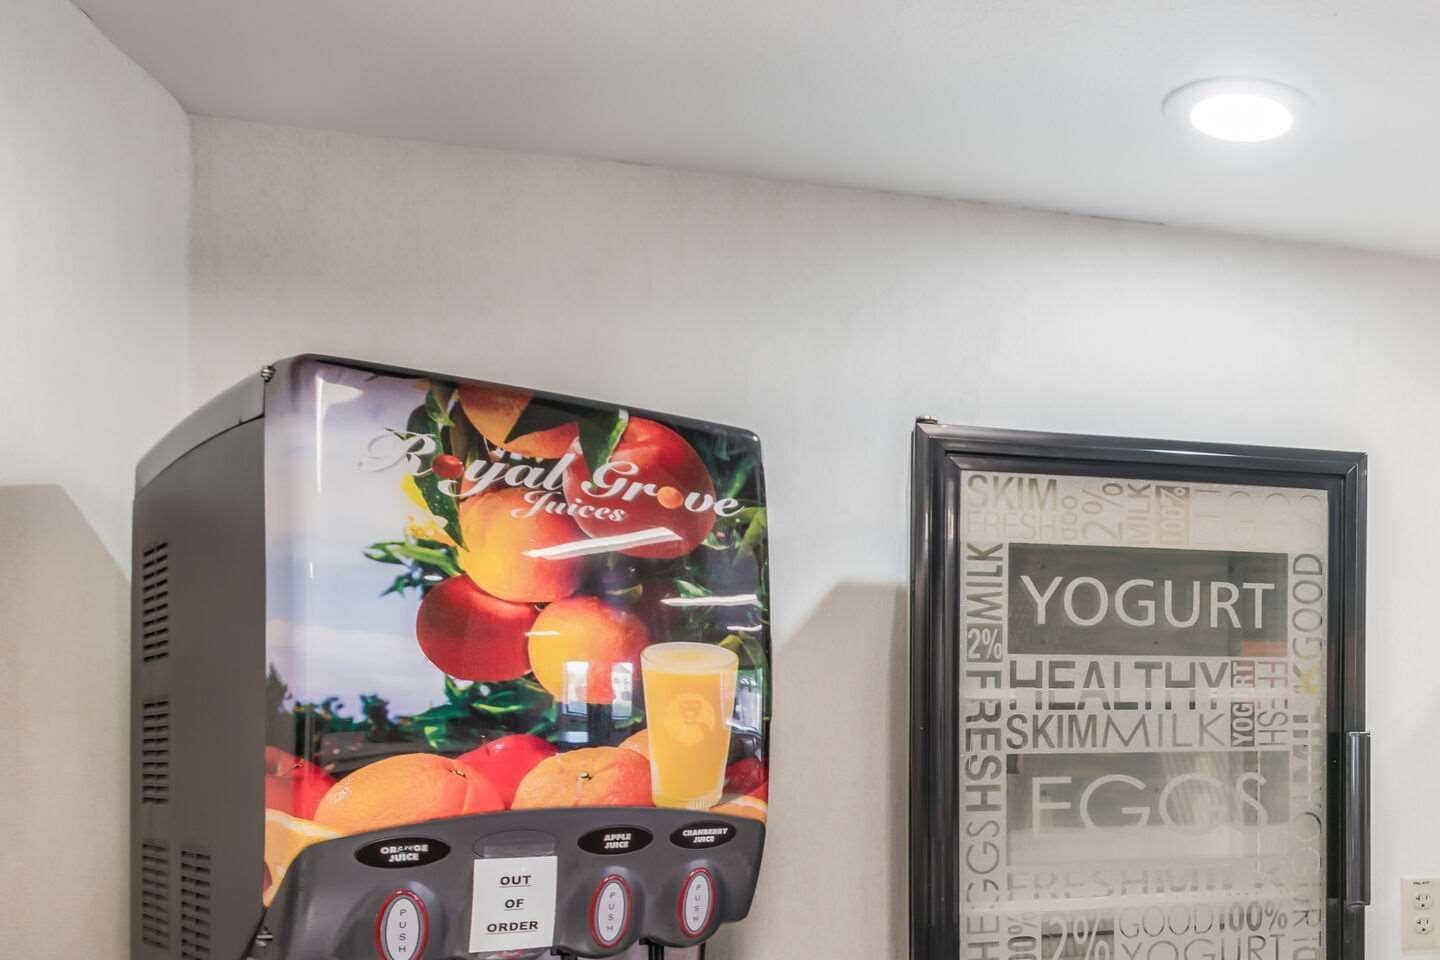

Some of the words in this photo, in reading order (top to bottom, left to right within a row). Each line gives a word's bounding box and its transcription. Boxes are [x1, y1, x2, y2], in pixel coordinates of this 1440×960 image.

[510, 491, 628, 523] Juices
[967, 474, 1058, 512] SKIM
[967, 543, 1003, 623] MILK
[1020, 576, 1276, 629] YOGURT
[1292, 554, 1323, 655] GOOD
[967, 629, 1002, 660] 2%
[1009, 661, 1229, 711] HEALTHY
[1007, 714, 1097, 750] SKIM
[1102, 714, 1226, 748] MILK
[380, 844, 429, 855] ORANGE
[603, 833, 632, 842] APPLE
[604, 841, 629, 849] JUICE
[692, 836, 715, 844] JUICE
[388, 852, 419, 863] JUICE
[499, 875, 532, 888] OUT
[504, 898, 525, 911] OF
[606, 891, 616, 931] PUSH
[398, 908, 407, 953] PUSH
[486, 920, 539, 935] ORDER
[1119, 905, 1213, 938] GOOD
